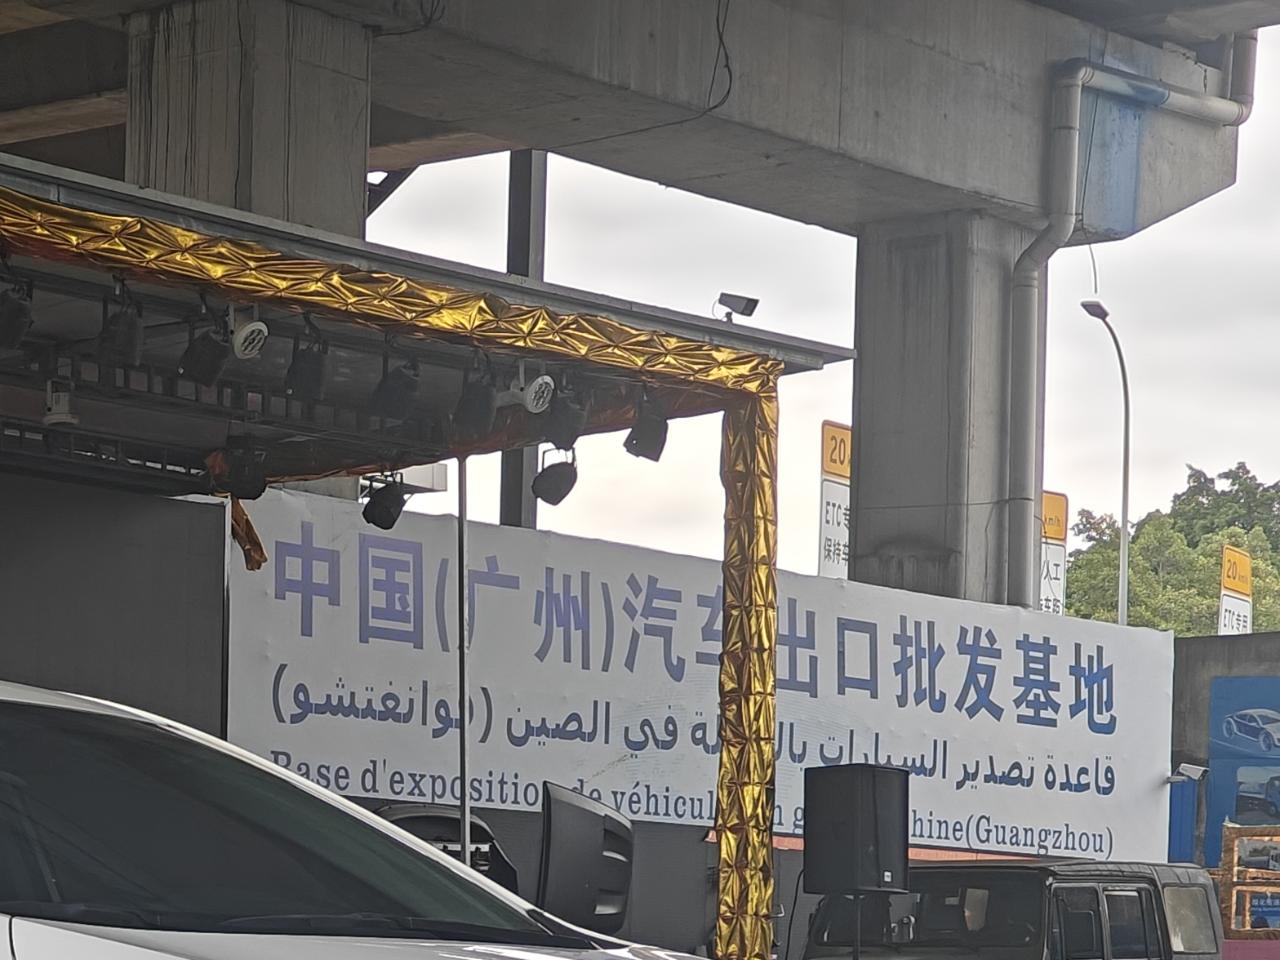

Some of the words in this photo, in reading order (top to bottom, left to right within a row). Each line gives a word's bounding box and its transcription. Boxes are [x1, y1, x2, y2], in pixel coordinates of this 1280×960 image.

[829, 435, 846, 466] 20
[506, 699, 612, 748] الصين
[956, 753, 1036, 792] تصدير
[1043, 755, 1117, 797] قاعدة
